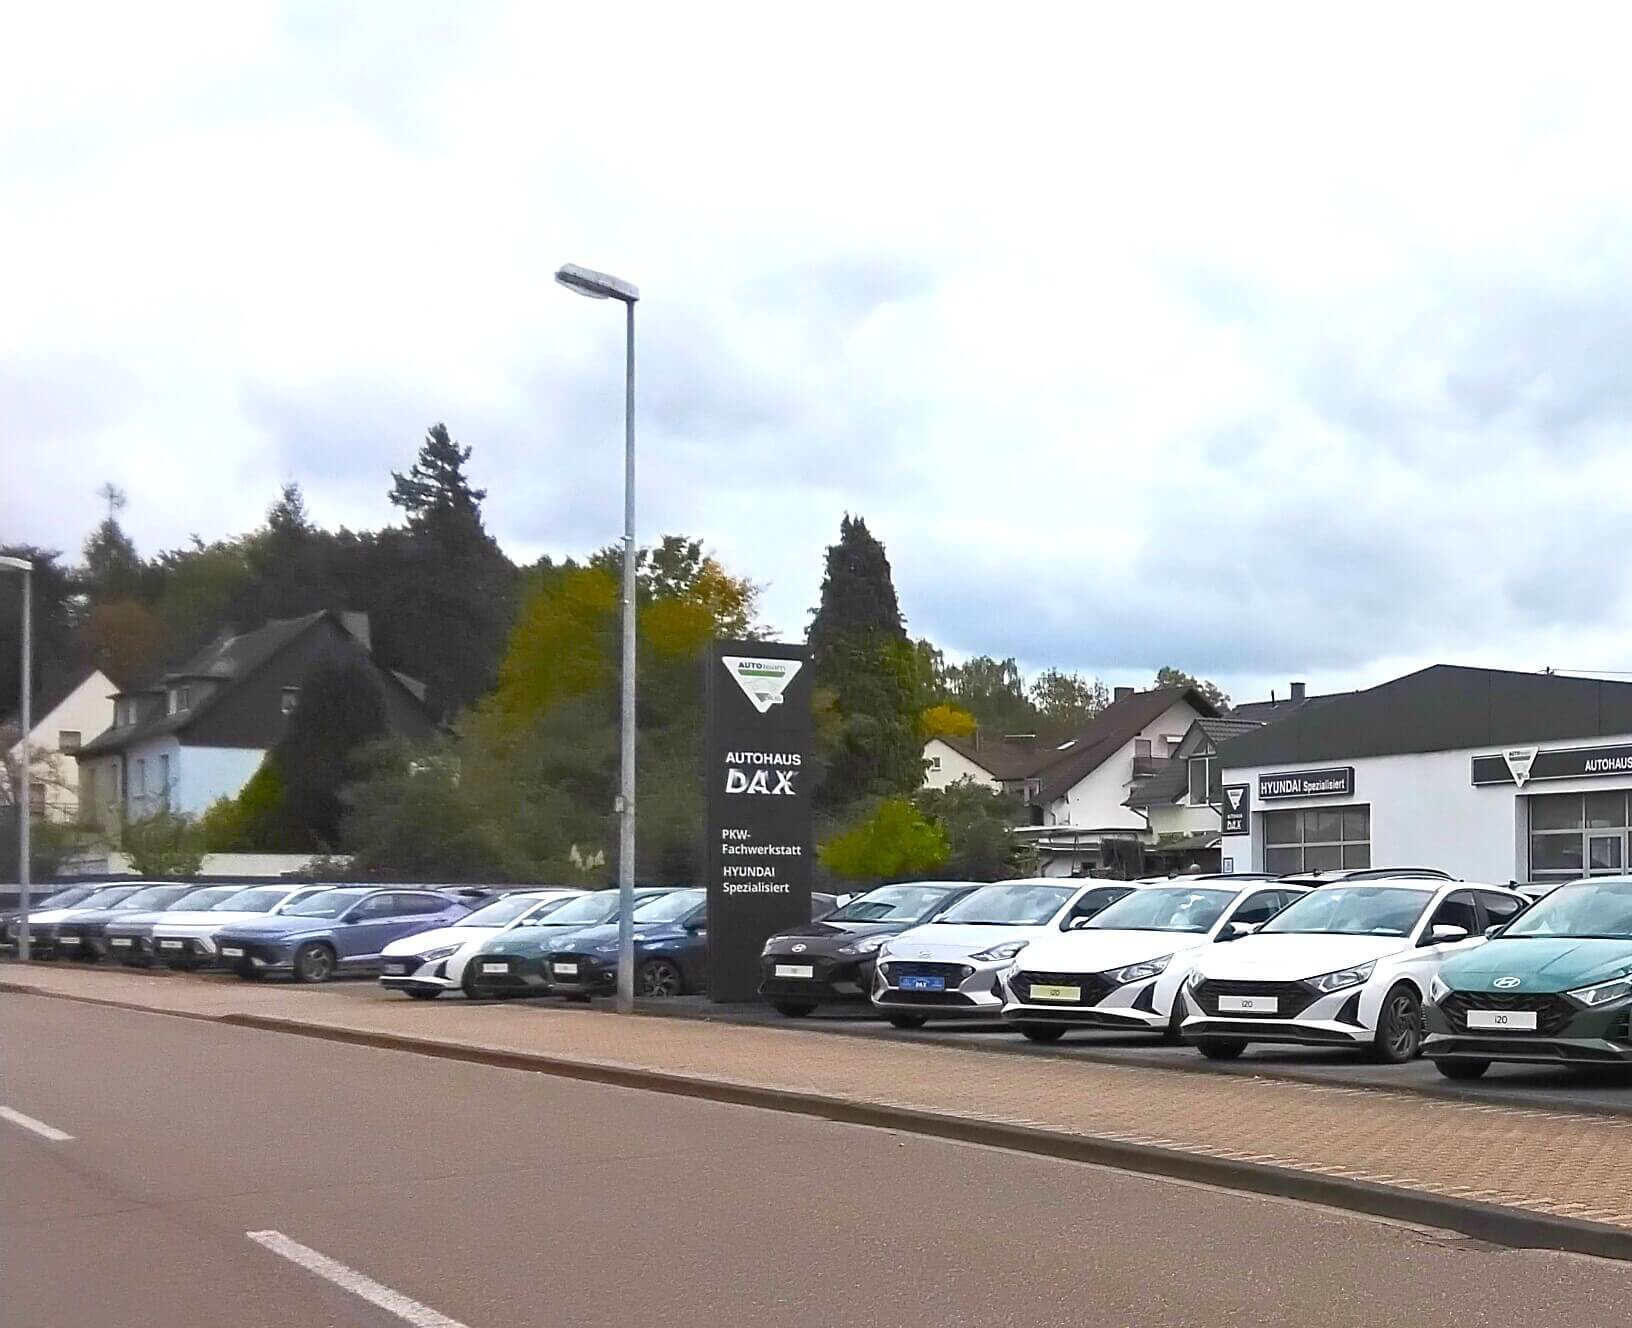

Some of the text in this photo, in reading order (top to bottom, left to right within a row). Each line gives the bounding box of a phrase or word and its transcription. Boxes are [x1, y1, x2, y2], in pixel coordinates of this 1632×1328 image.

[725, 751, 802, 766] AUTOHAUS
[725, 768, 799, 795] DAX
[1261, 778, 1345, 795] HYUNDAI Spezialisiert
[722, 829, 752, 840] PKW-
[722, 843, 802, 856] Fachwerkstatt
[723, 866, 775, 877] HYUNDAI
[722, 882, 790, 895] Spezialisiert
[1494, 1015, 1508, 1025] i20
